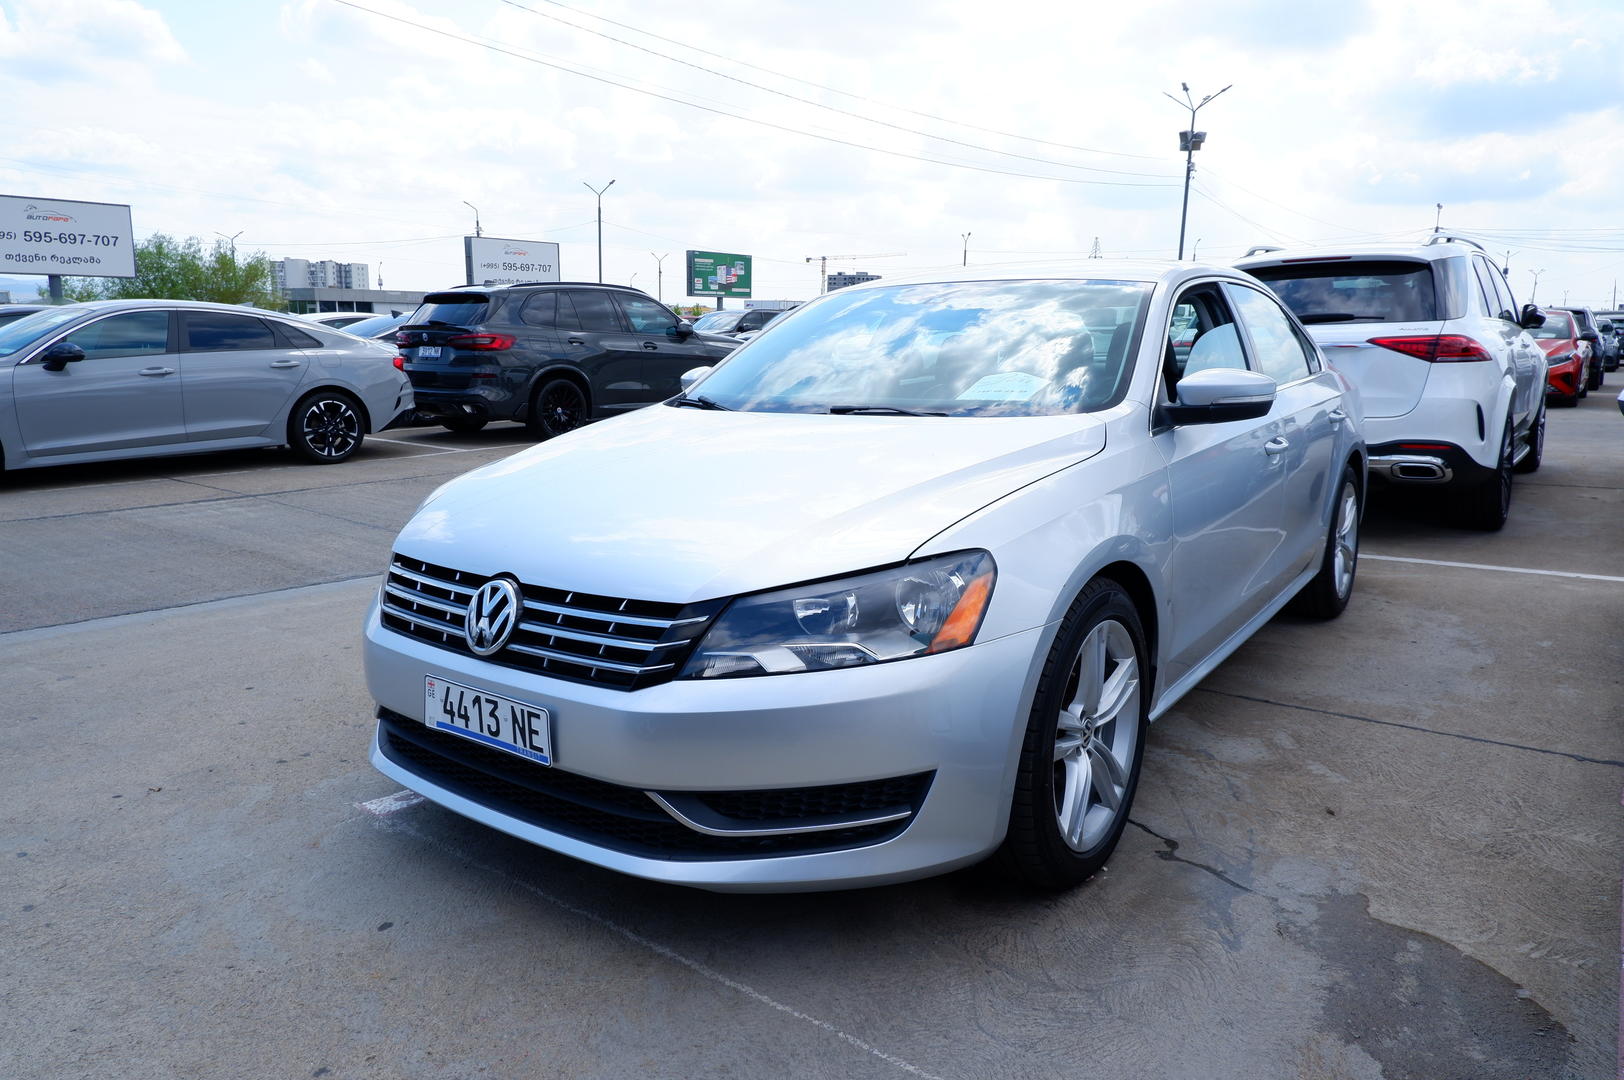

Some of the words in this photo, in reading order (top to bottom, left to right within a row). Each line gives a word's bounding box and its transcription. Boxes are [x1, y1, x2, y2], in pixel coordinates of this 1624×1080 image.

[24, 230, 119, 247] 595-697-707
[5, 253, 47, 263] თქვენი
[50, 254, 101, 265] რეკლამა
[502, 262, 552, 273] 595-697-707
[443, 686, 501, 738] 4413
[510, 705, 544, 753] NE
